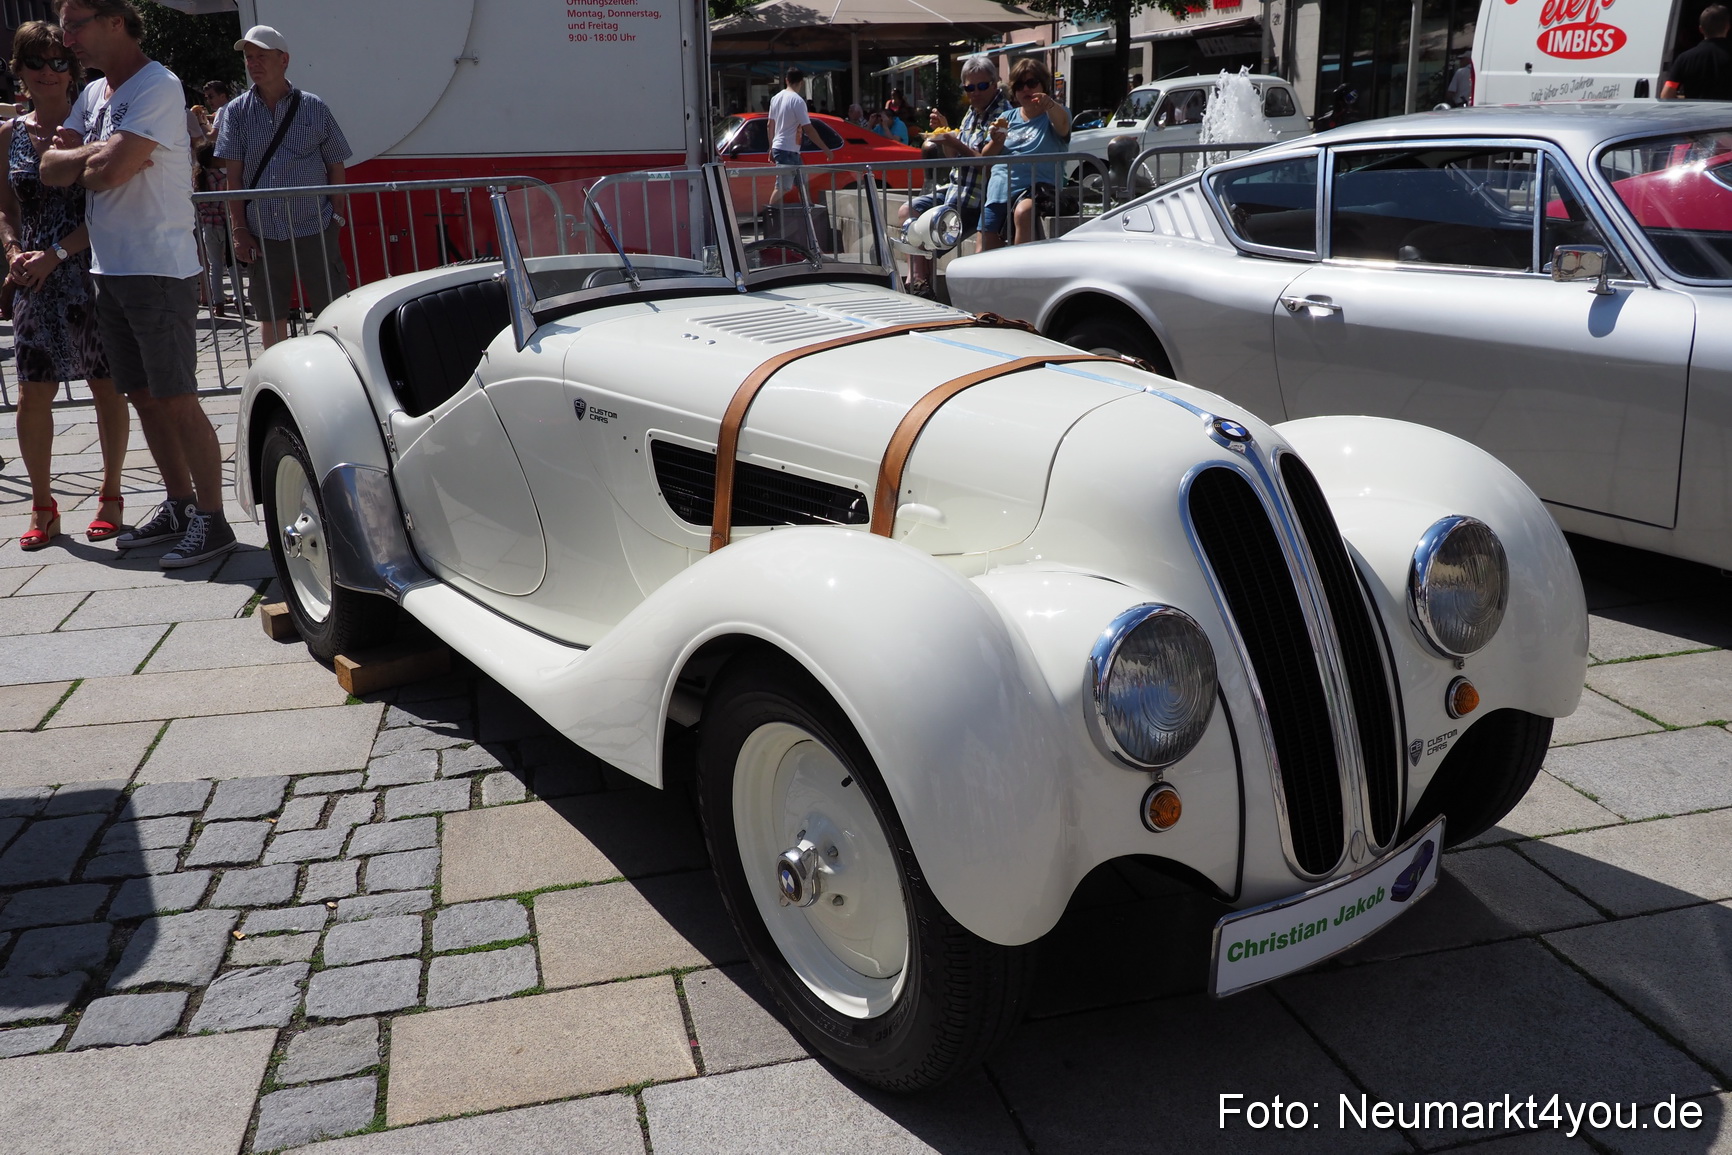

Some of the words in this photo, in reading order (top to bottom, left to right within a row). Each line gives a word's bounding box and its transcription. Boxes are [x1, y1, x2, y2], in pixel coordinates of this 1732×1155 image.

[567, 9, 606, 20] Montag,
[607, 9, 662, 20] Donnerstag,
[568, 21, 586, 30] und
[588, 21, 619, 31] Freitag
[568, 33, 588, 42] 9:00
[593, 33, 618, 42] 18:00
[620, 33, 636, 42] Uhr
[1546, 28, 1615, 53] IMBISS
[1559, 83, 1570, 96] 50
[1570, 76, 1595, 94] Jahren
[589, 413, 609, 424] CARS
[590, 406, 617, 419] CUSTOM
[1427, 729, 1457, 747] CUSTOM
[1427, 741, 1447, 755] CARS
[1226, 916, 1328, 963] Christian
[1333, 886, 1385, 927] Jakob
